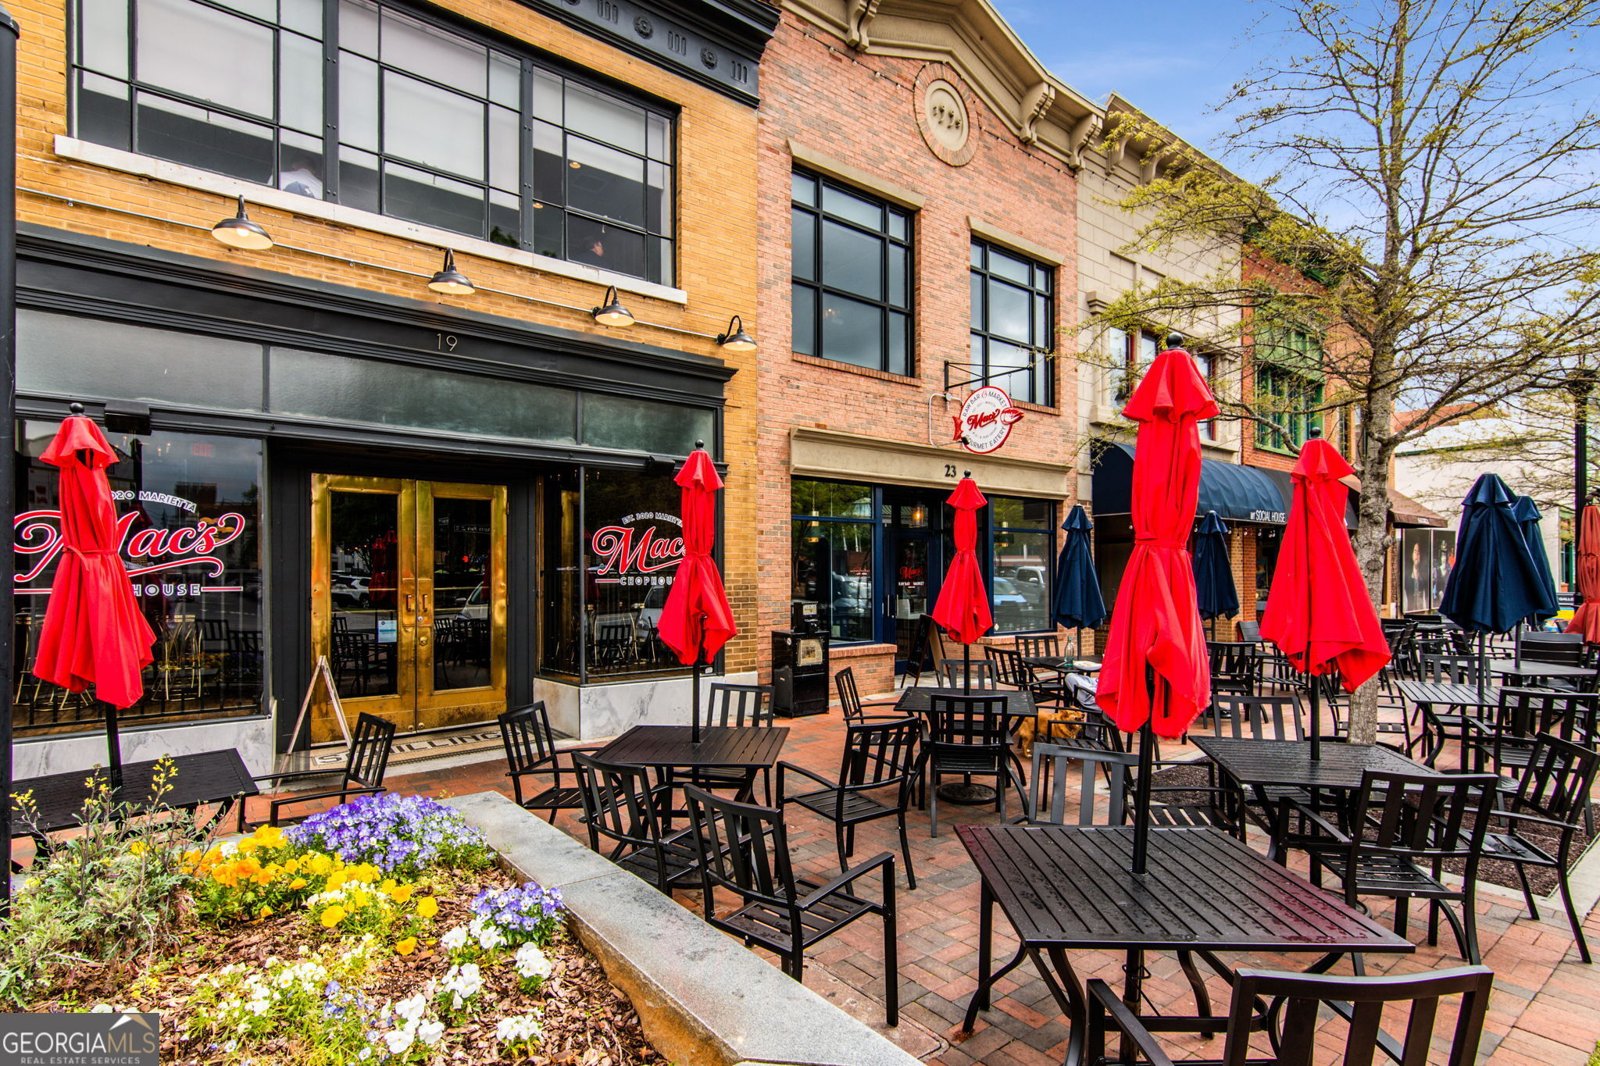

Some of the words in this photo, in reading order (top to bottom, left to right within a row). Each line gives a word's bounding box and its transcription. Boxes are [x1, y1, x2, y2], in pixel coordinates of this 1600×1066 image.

[436, 333, 458, 352] 19
[988, 391, 1008, 408] MARKET
[989, 426, 1006, 448] EATERY
[944, 464, 957, 478] 23
[138, 490, 197, 513] MARIETTA
[1255, 510, 1271, 522] SOCIAL
[1271, 512, 1286, 523] HOUSE
